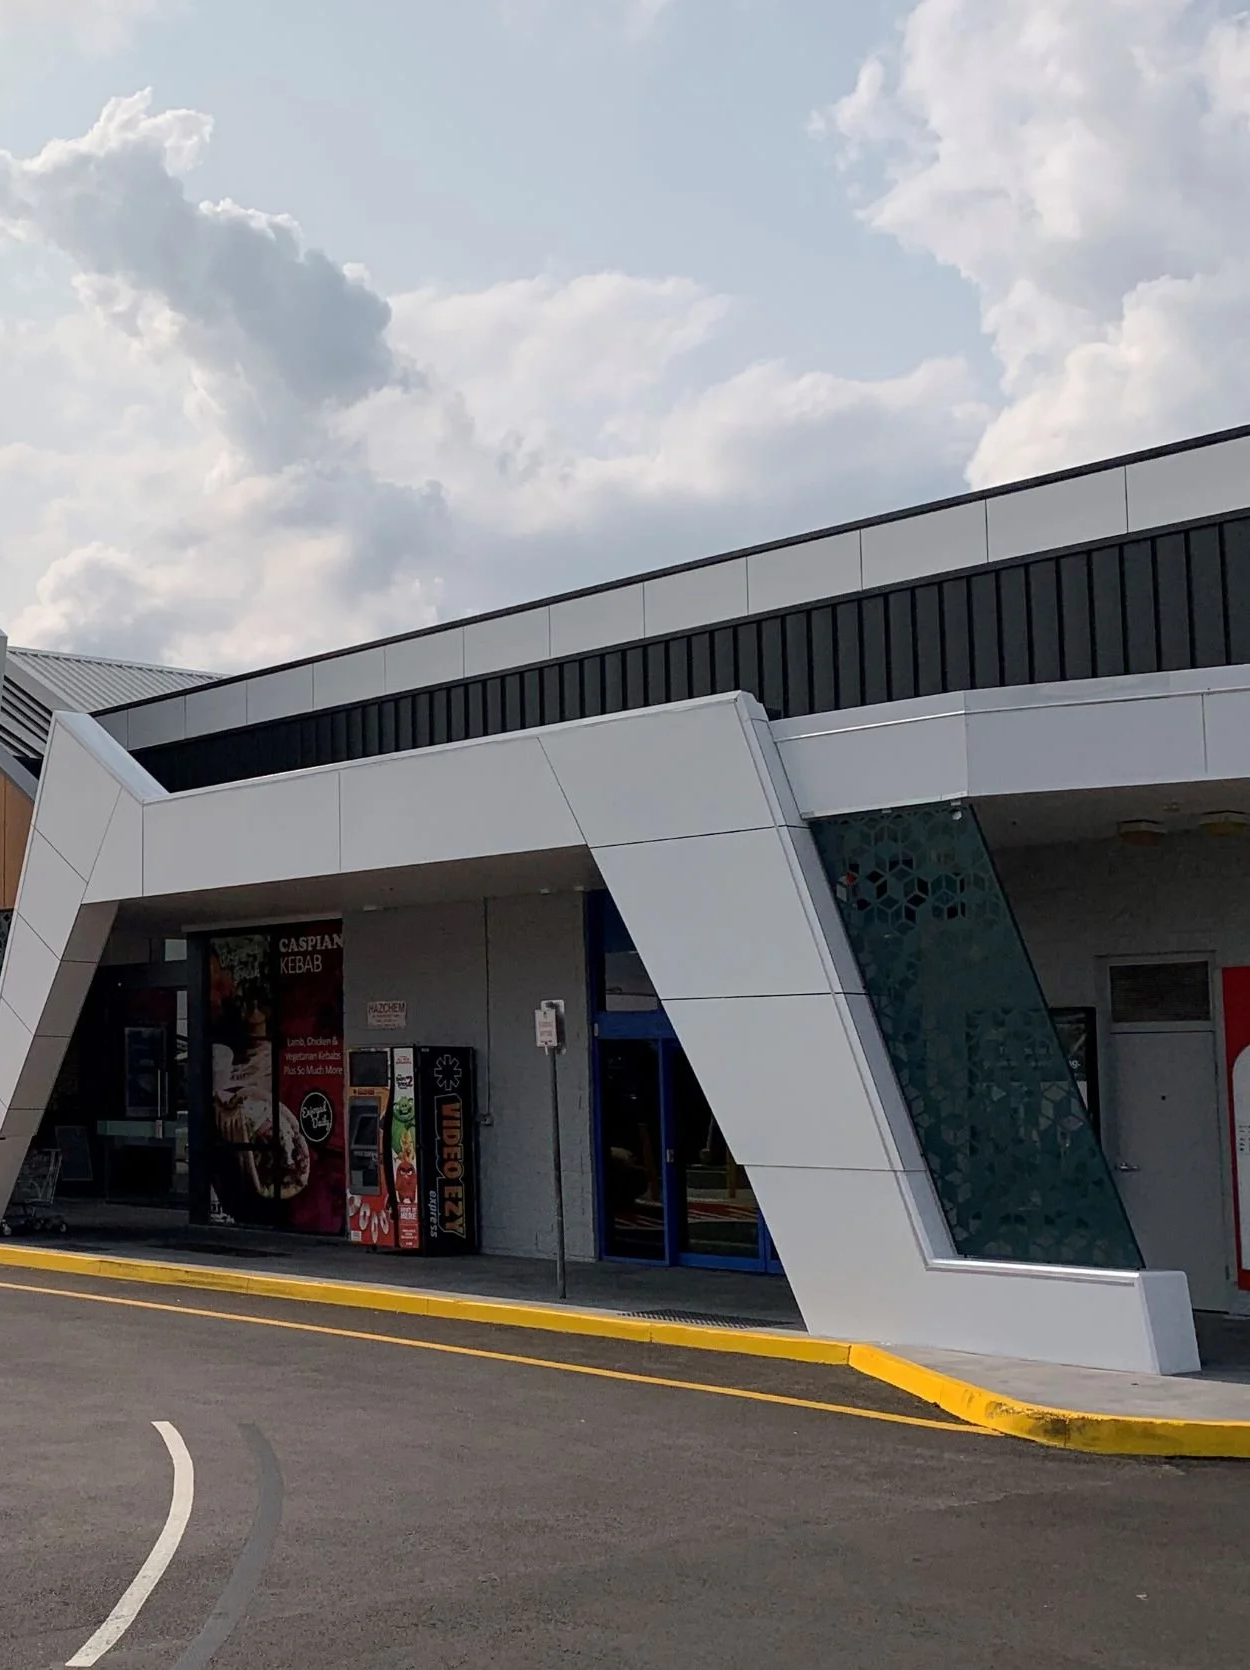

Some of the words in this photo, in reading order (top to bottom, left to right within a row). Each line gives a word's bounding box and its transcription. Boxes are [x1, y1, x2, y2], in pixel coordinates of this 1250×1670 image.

[278, 934, 343, 952] CASPIAN
[280, 955, 323, 974] KEBAB
[369, 1002, 406, 1013] HAZCHEM
[442, 1102, 463, 1179] VIDEO
[428, 1190, 438, 1238] express
[444, 1186, 464, 1234] EZY
